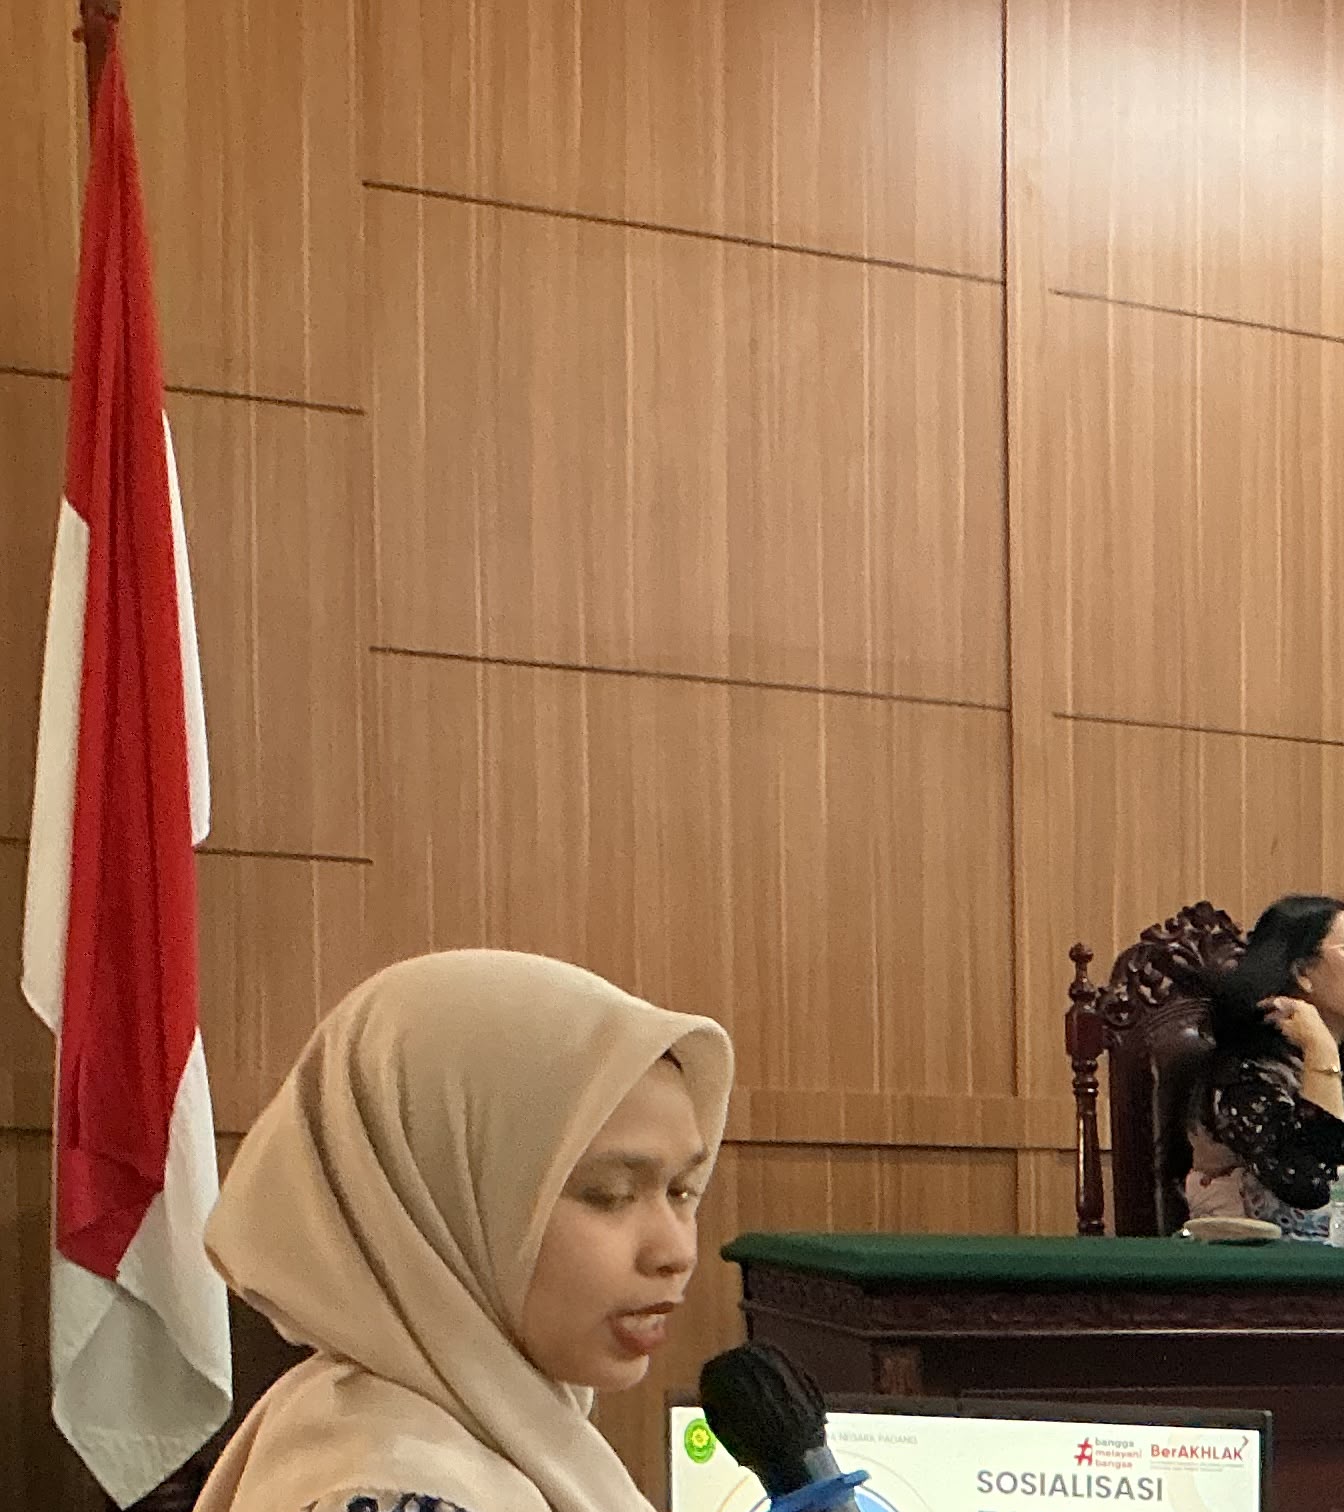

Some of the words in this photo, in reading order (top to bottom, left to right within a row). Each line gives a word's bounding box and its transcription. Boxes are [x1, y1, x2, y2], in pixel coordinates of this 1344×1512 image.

[1095, 1437, 1135, 1449] bangga
[1095, 1448, 1142, 1460] melayani
[1151, 1441, 1244, 1462] BerAKHLAK
[977, 1470, 1163, 1501] SOSIALISASI
